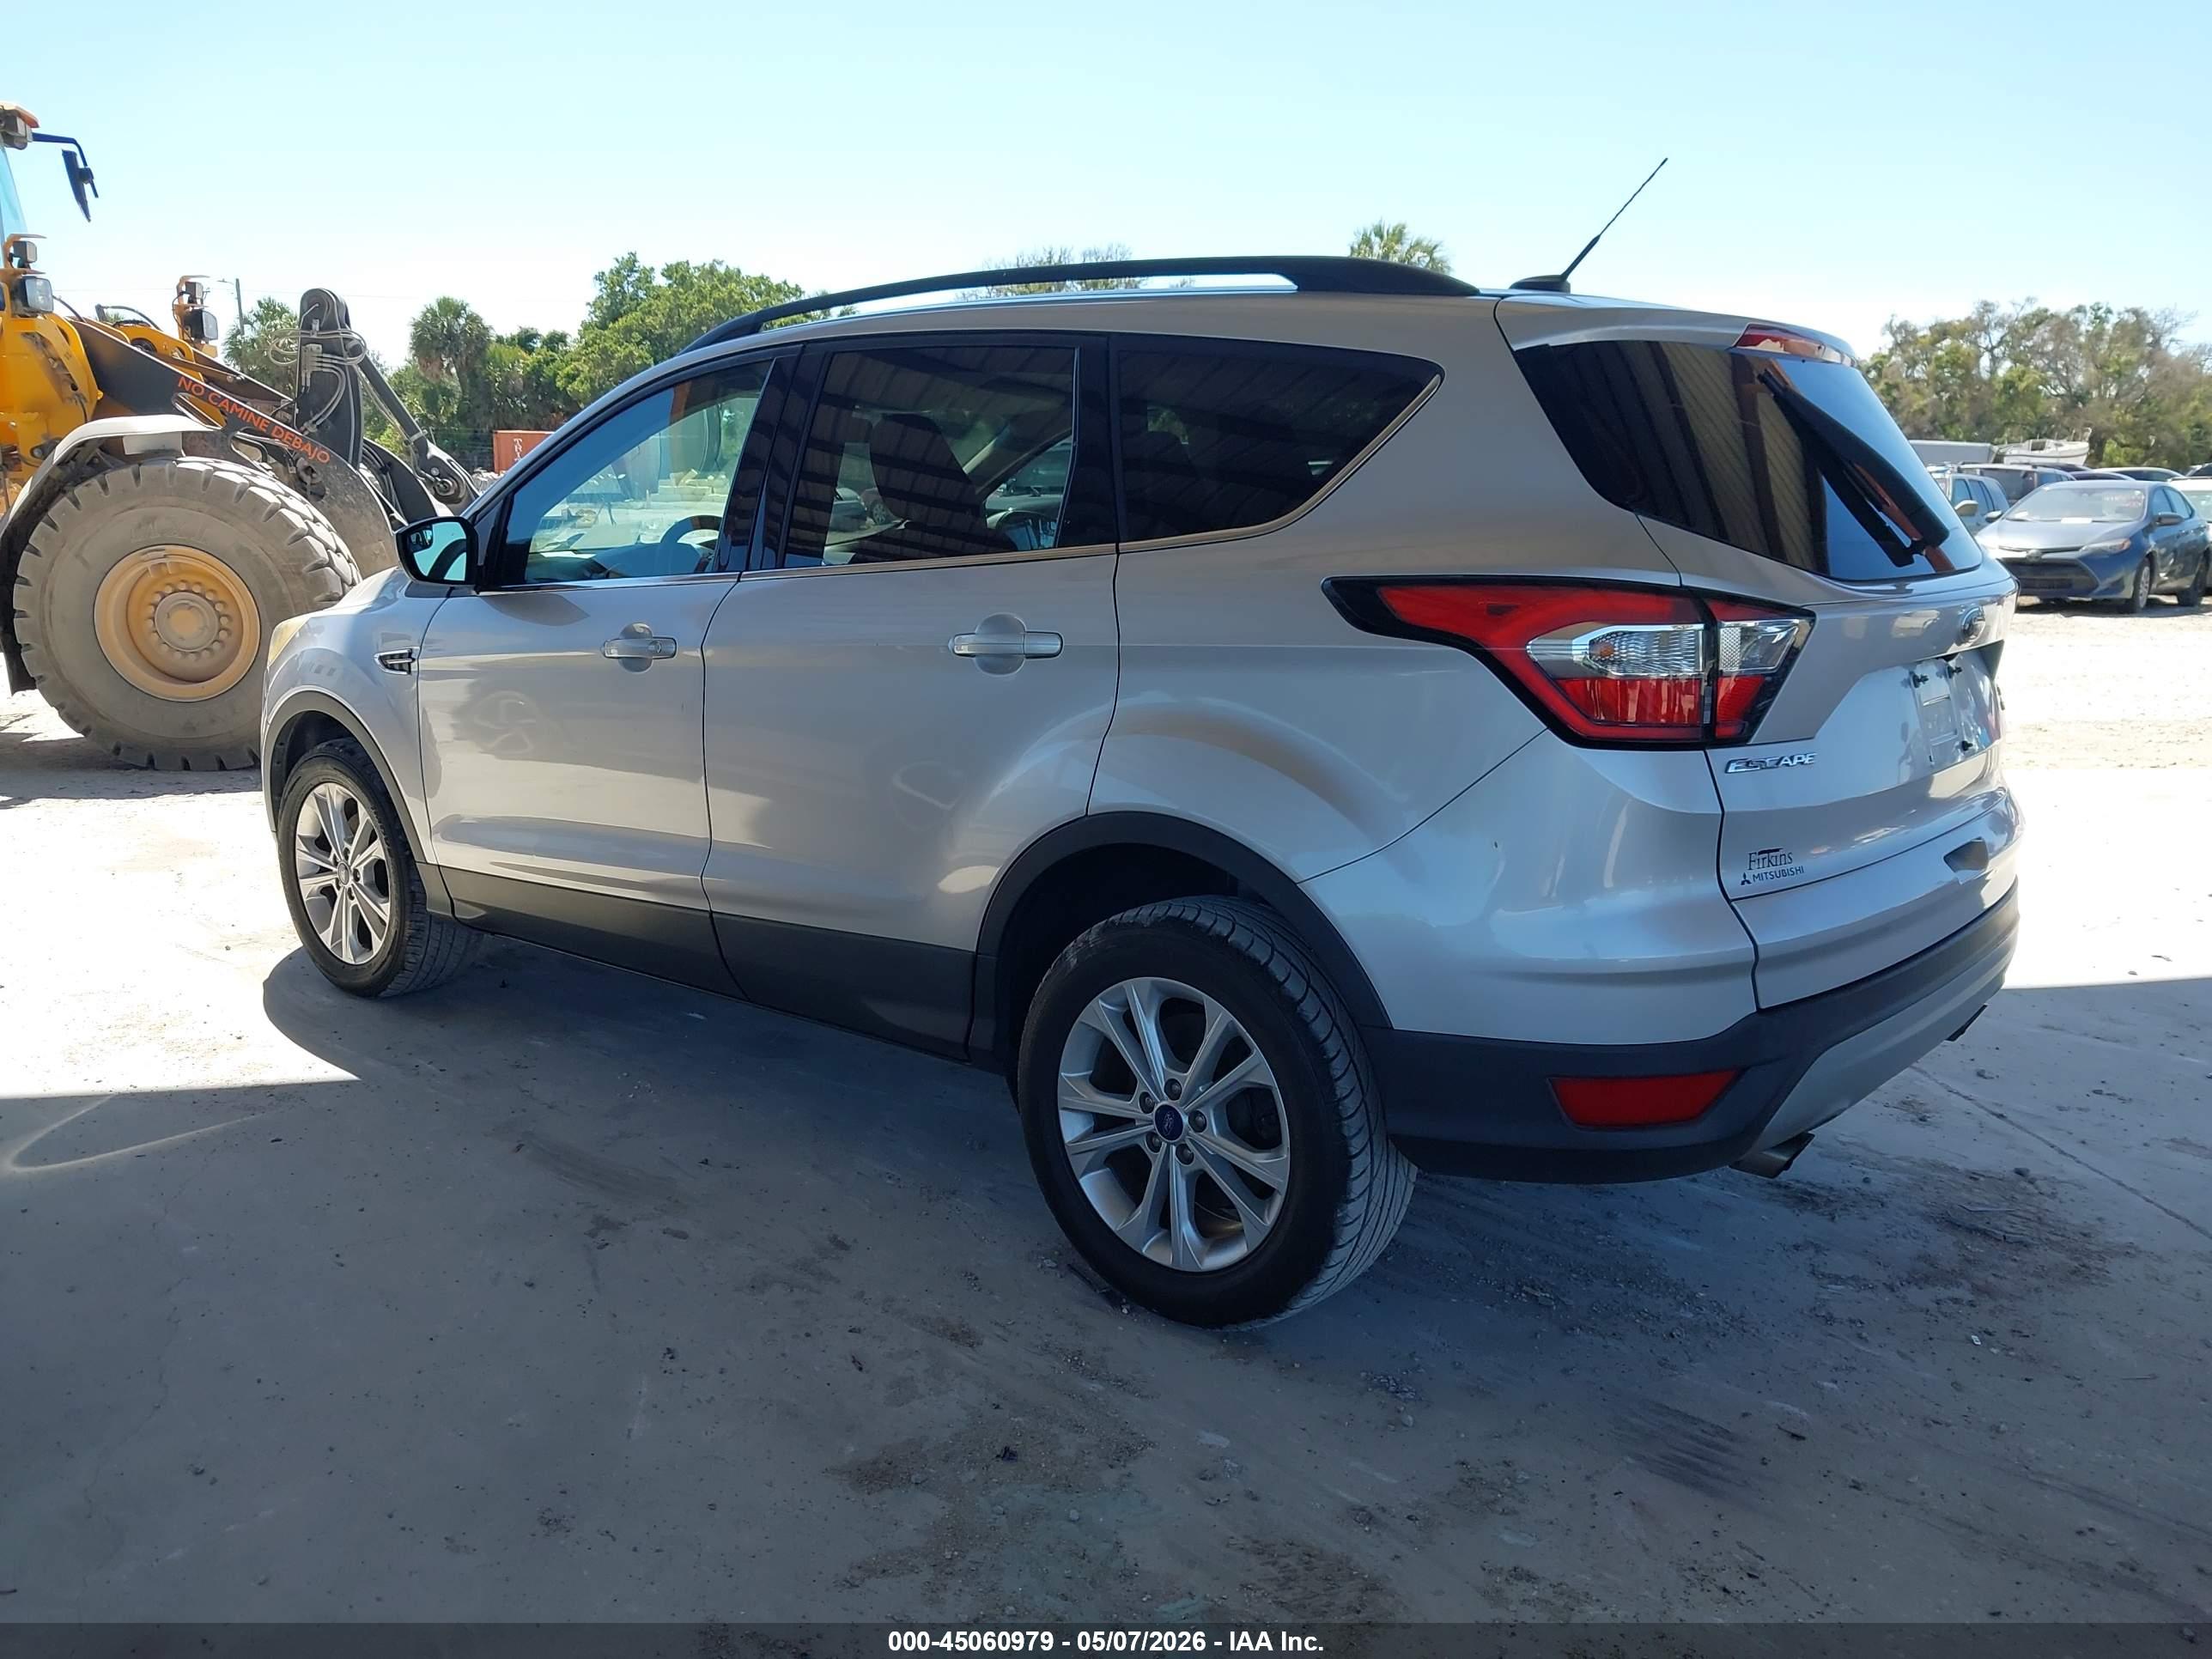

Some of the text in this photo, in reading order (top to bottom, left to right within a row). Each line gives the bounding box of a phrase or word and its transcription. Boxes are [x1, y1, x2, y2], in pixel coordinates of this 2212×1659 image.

[178, 376, 331, 464] NO CAMINE DEBAJO
[1725, 752, 1817, 773] ESCAPE
[1747, 851, 1793, 870] Firkins
[1753, 866, 1804, 882] MITSUBISHI
